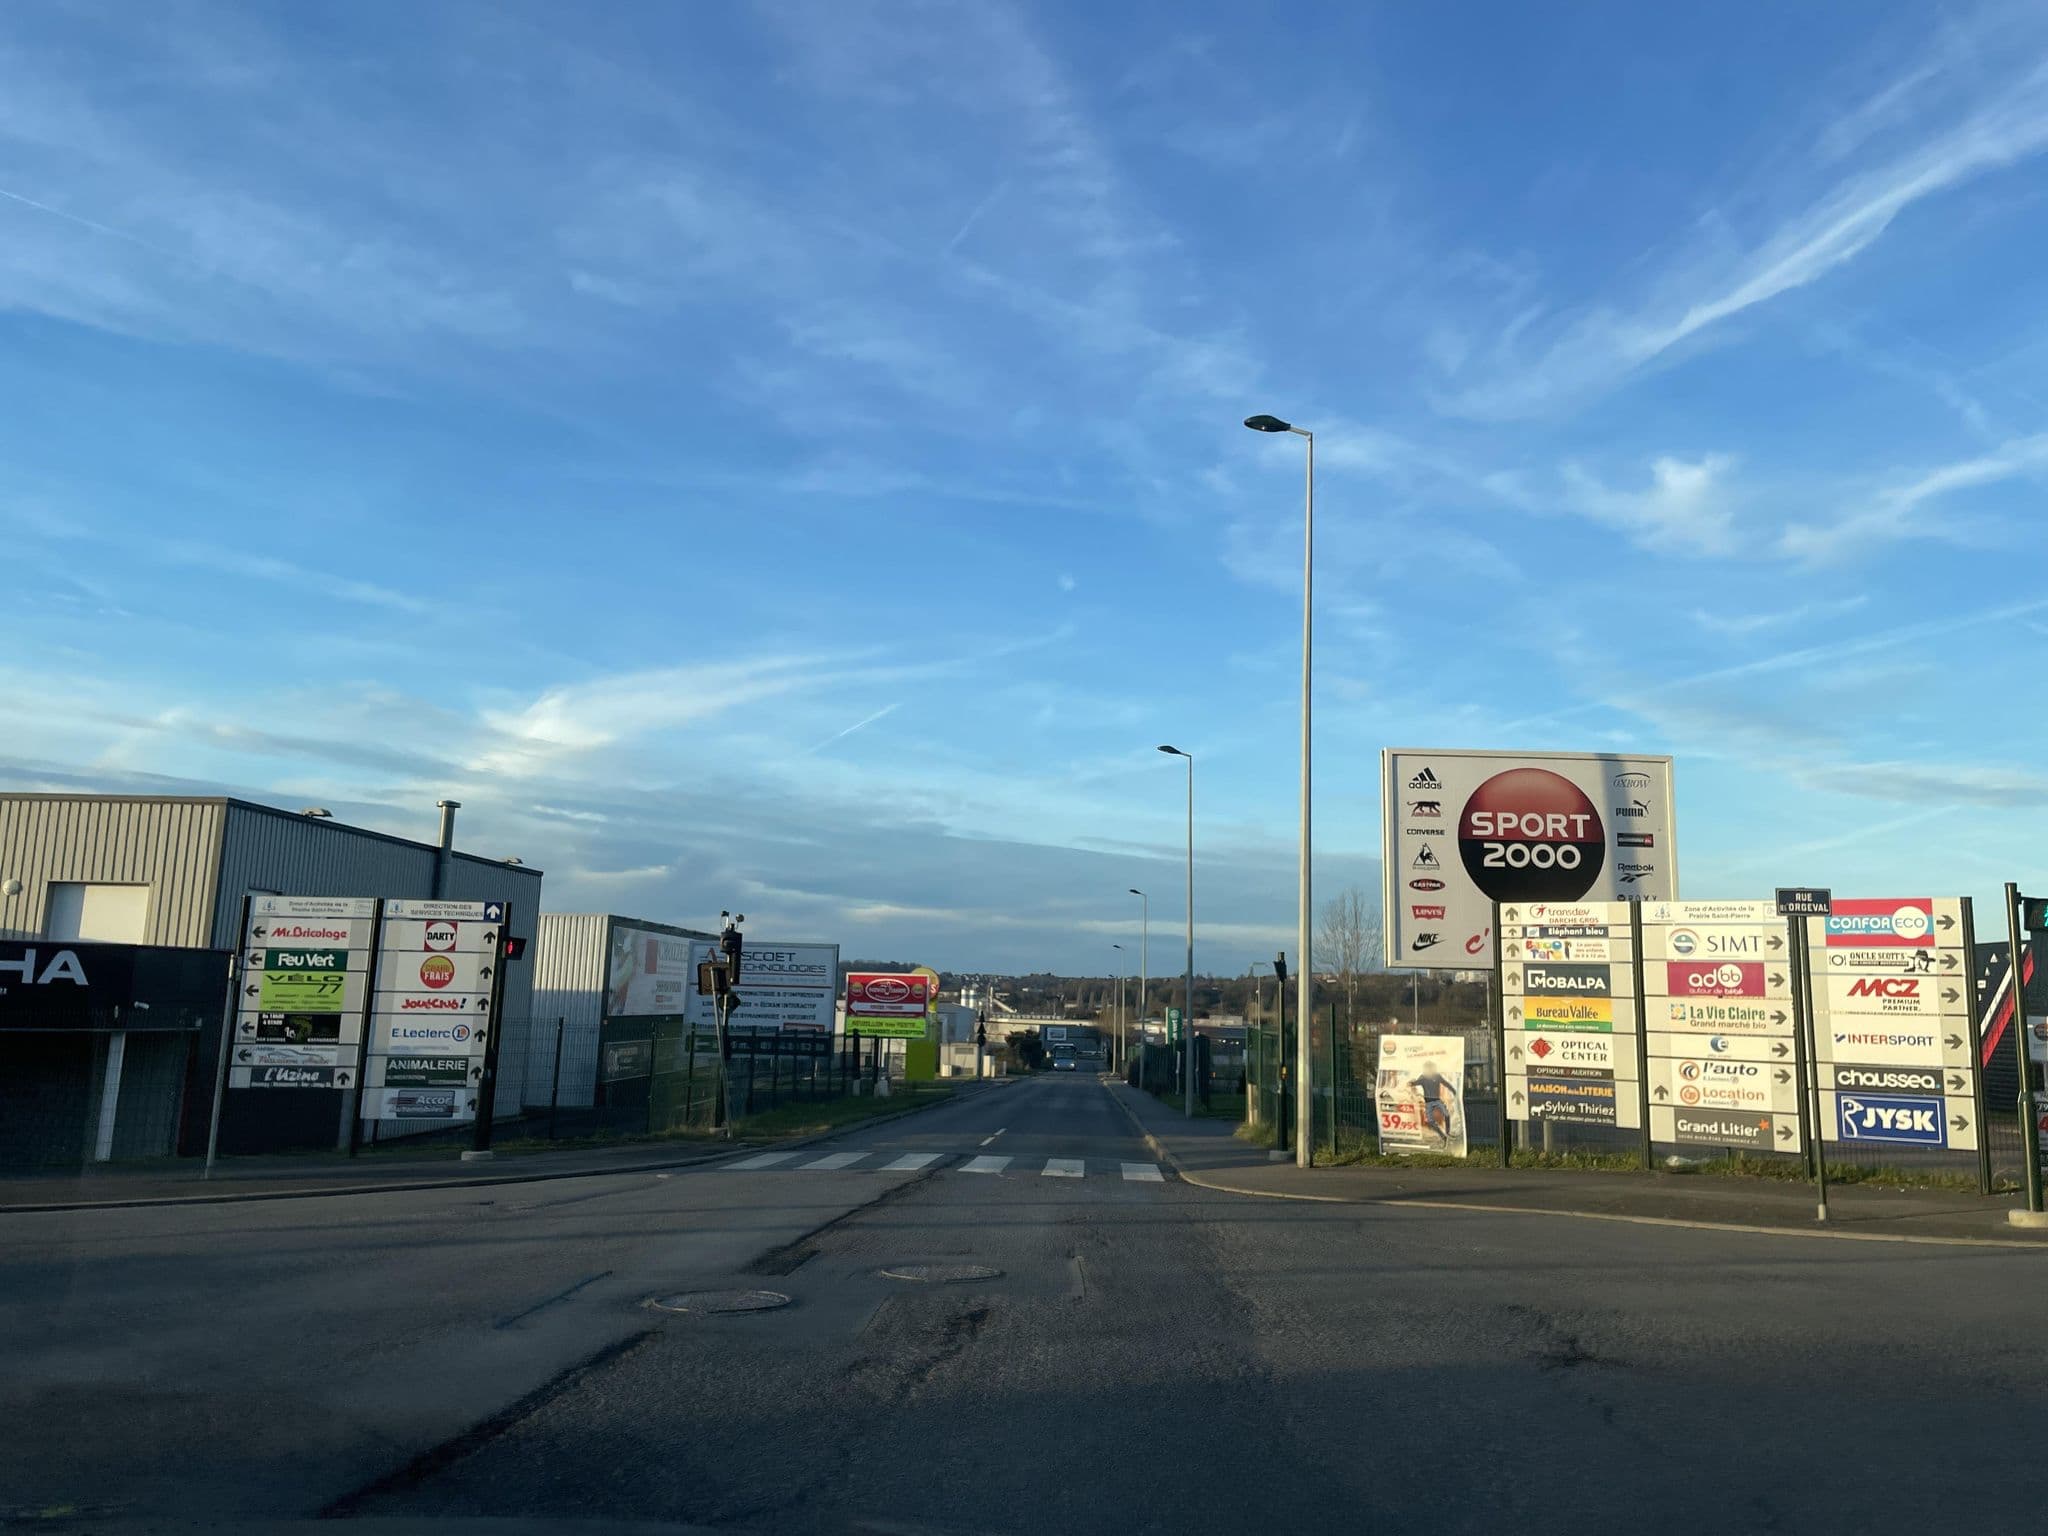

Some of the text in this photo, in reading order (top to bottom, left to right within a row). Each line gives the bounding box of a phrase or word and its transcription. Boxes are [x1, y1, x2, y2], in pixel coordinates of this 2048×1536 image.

[1408, 780, 1442, 790] adidas
[1615, 808, 1645, 817] PUMA
[1471, 812, 1590, 838] SPORT
[1406, 828, 1445, 836] CONVERSE
[1483, 843, 1581, 869] 2000
[1617, 863, 1654, 872] Reebok
[1795, 893, 1813, 902] RUE
[1548, 907, 1590, 917] transdev
[1894, 917, 1926, 929] ECO
[427, 932, 455, 941] DARTY
[1586, 927, 1604, 936] bleu
[1417, 933, 1440, 943] NIKE
[1707, 936, 1762, 952] SIMT
[278, 953, 335, 967] Feu Vert
[740, 951, 797, 962] SCOET
[1850, 952, 1876, 961] ONCLE
[424, 971, 450, 981] FRAIS
[1534, 976, 1606, 989] MOBALPA
[1847, 979, 1920, 997] MCZ
[317, 983, 342, 994] 77
[1536, 1005, 1599, 1019] Bureau Vallée
[1690, 1006, 1766, 1020] La Vie Claire
[1690, 1020, 1716, 1028] Grand
[1718, 1021, 1751, 1029] marché
[1561, 1040, 1609, 1051] OPTICAL
[1848, 1034, 1934, 1046] INTERSPORT
[1562, 1052, 1608, 1062] CENTER
[388, 1060, 466, 1071] ANIMALERIE
[1703, 1062, 1759, 1076] l'auto
[1571, 1069, 1602, 1077] AUDITION
[1530, 1083, 1567, 1094] MAISON
[1579, 1086, 1613, 1097] LITERIE
[1703, 1087, 1765, 1101] Location
[1545, 1101, 1615, 1116] Sylvie Thiriez
[1862, 1107, 1936, 1132] JYSK
[1677, 1119, 1759, 1137] Grand Litier
